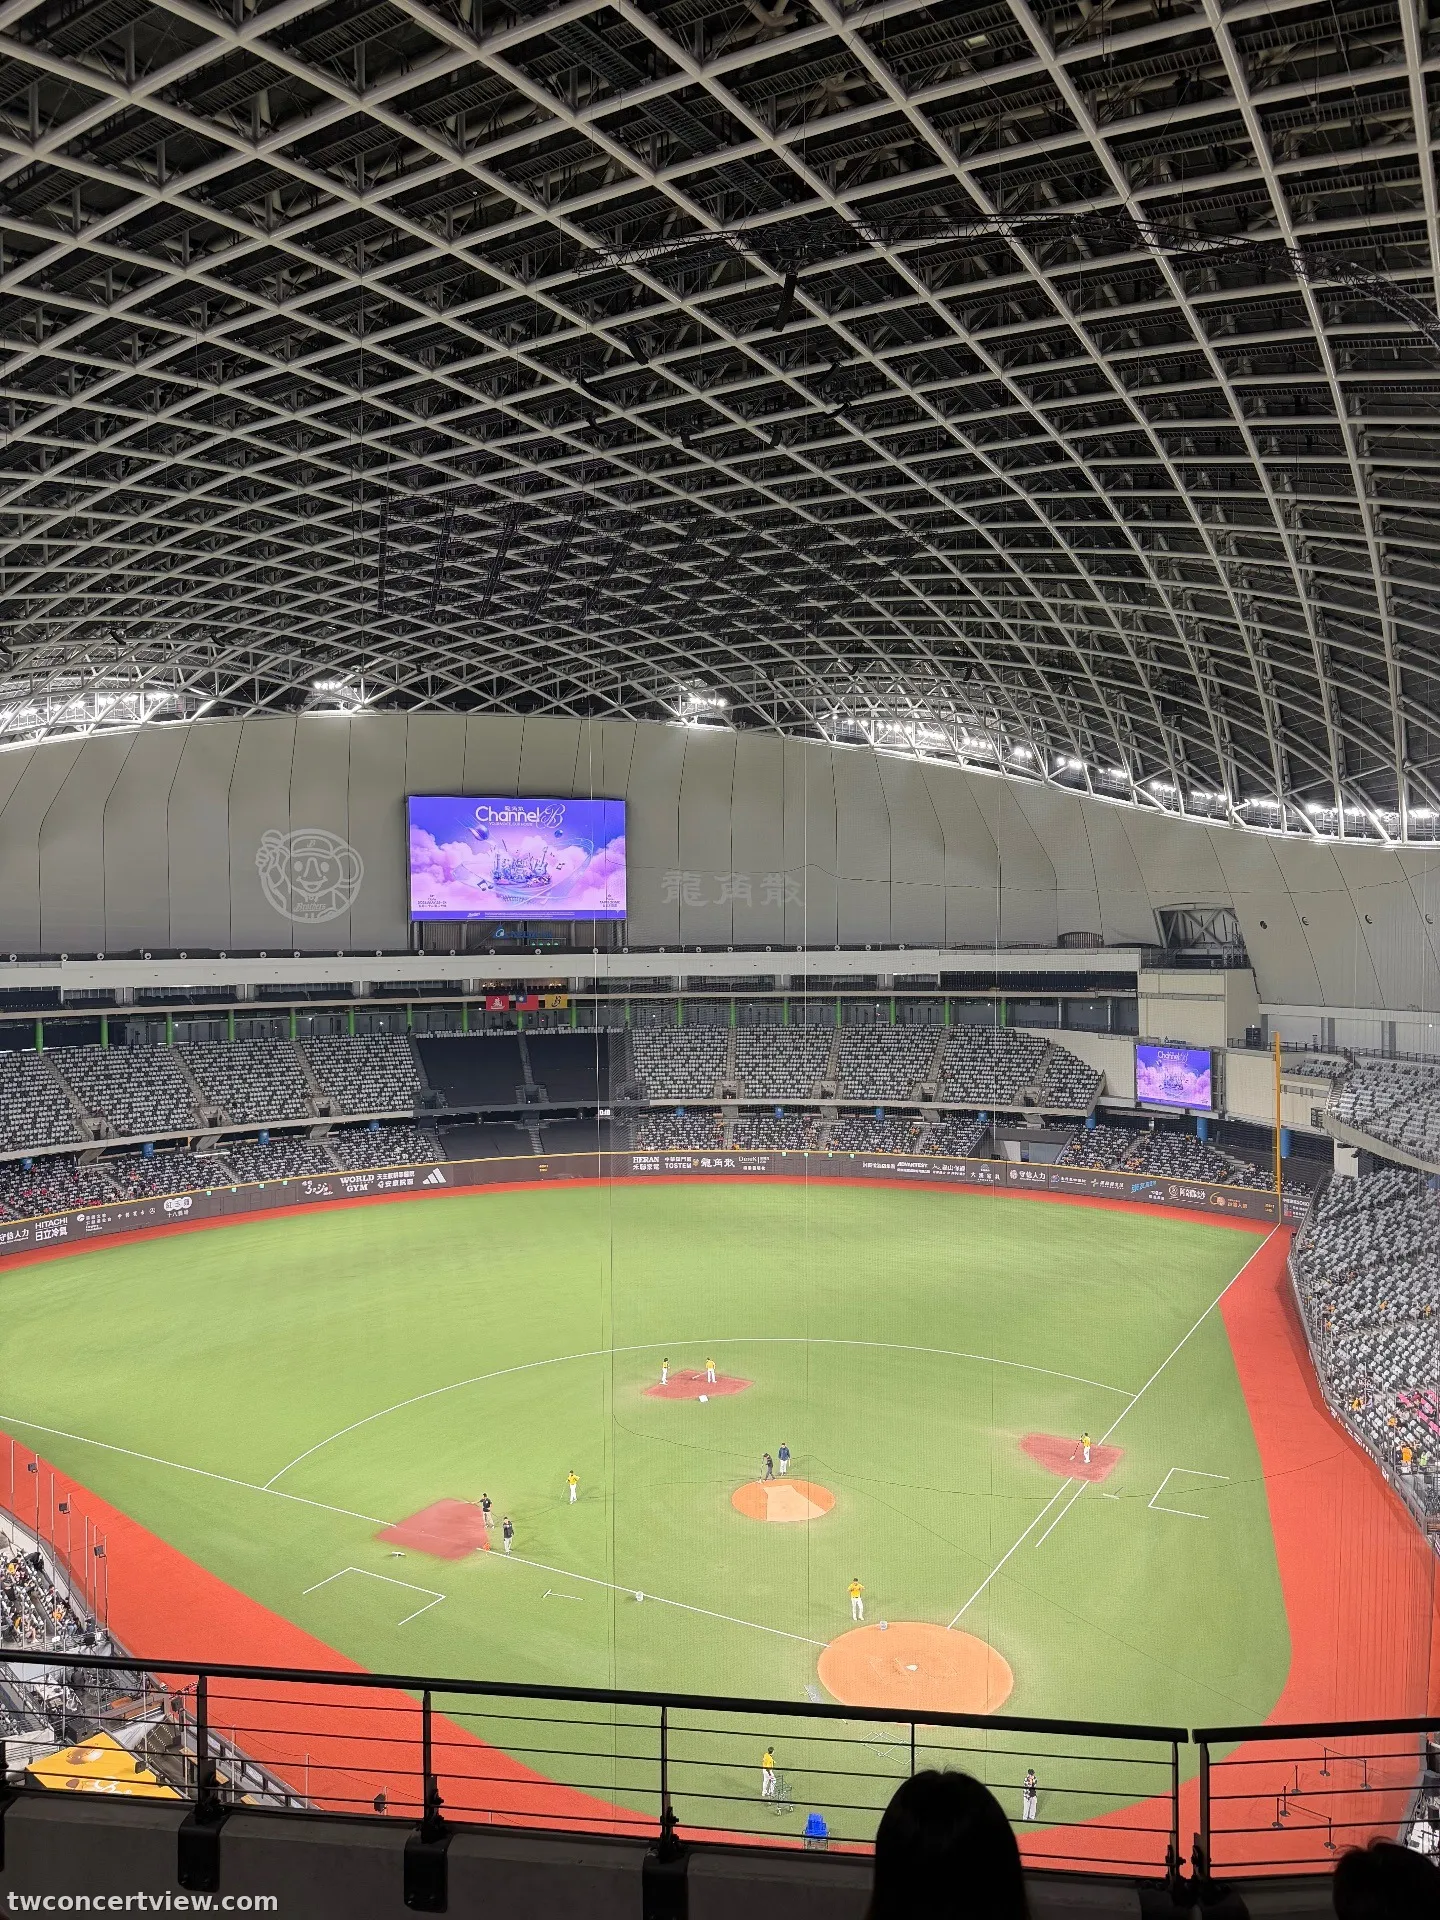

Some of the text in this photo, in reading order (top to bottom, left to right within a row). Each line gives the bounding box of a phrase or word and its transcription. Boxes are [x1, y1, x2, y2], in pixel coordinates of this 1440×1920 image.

[475, 806, 540, 823] Channel
[660, 871, 805, 907] 龍角散
[633, 1156, 660, 1164] HERAN
[701, 1157, 736, 1168] 龍角散
[340, 1174, 375, 1184] WORLD
[347, 1184, 369, 1192] GYM
[35, 1216, 68, 1230] HITACHI
[35, 1226, 68, 1241] 日立冷氣
